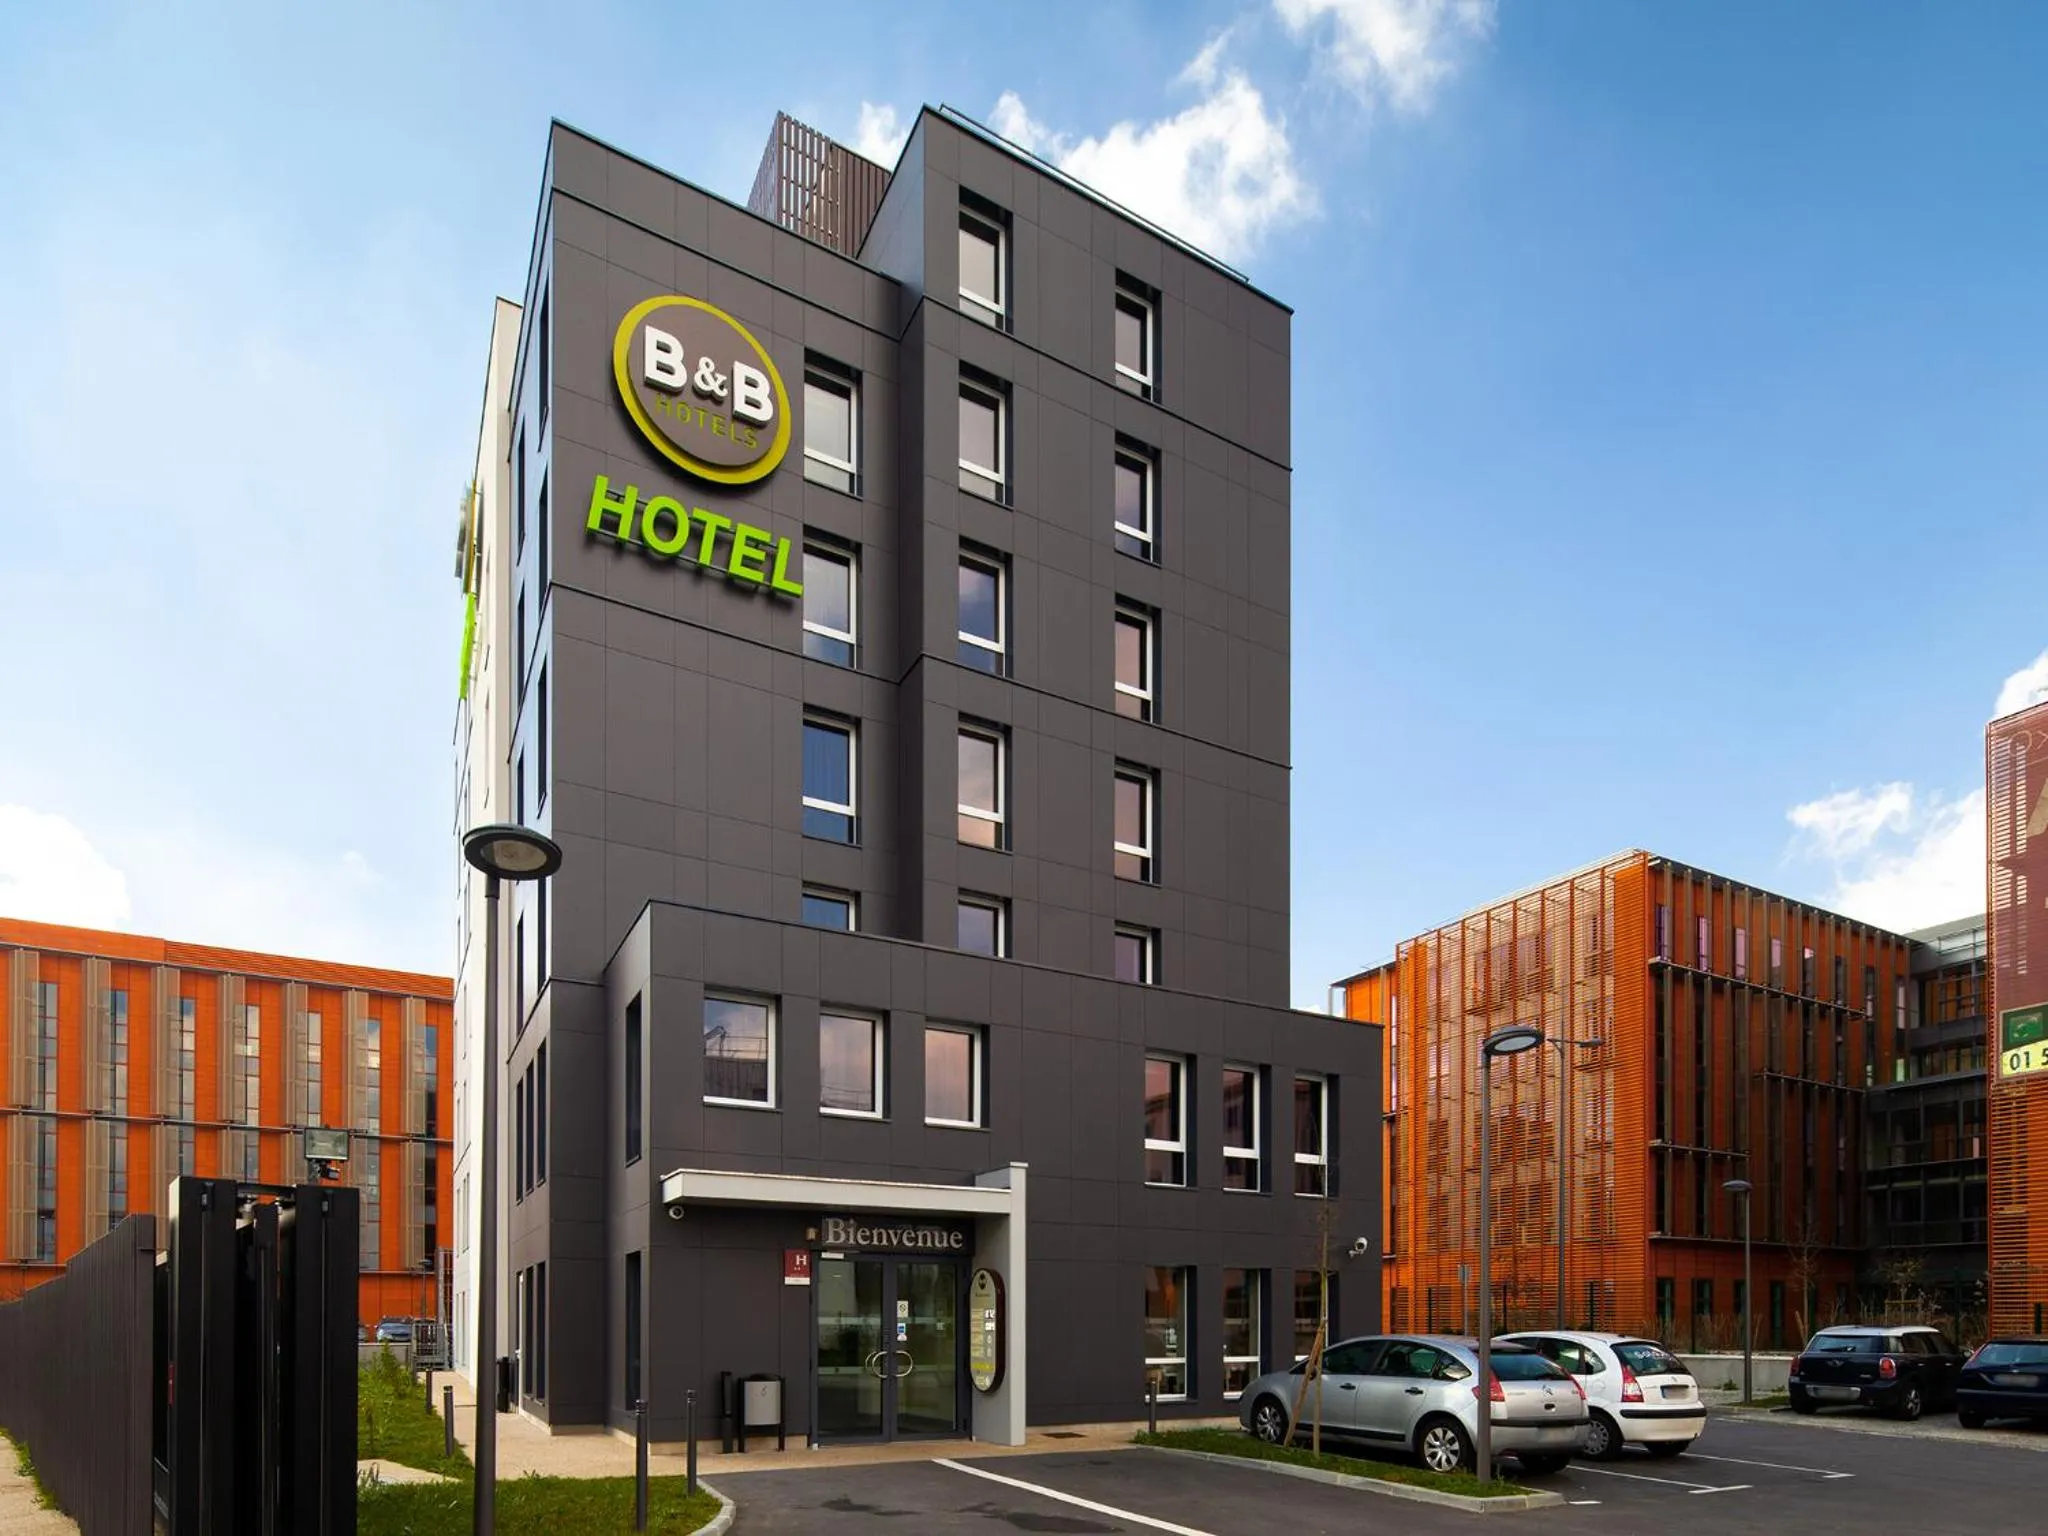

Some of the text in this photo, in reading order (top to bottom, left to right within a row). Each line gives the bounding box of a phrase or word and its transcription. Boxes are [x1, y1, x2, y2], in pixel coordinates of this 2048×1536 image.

[644, 325, 773, 422] B&B
[655, 394, 758, 449] HOTELS
[586, 475, 803, 596] HOTEL
[2009, 1051, 2031, 1071] 01
[826, 1218, 963, 1248] Bienvenue
[796, 1254, 807, 1266] H
